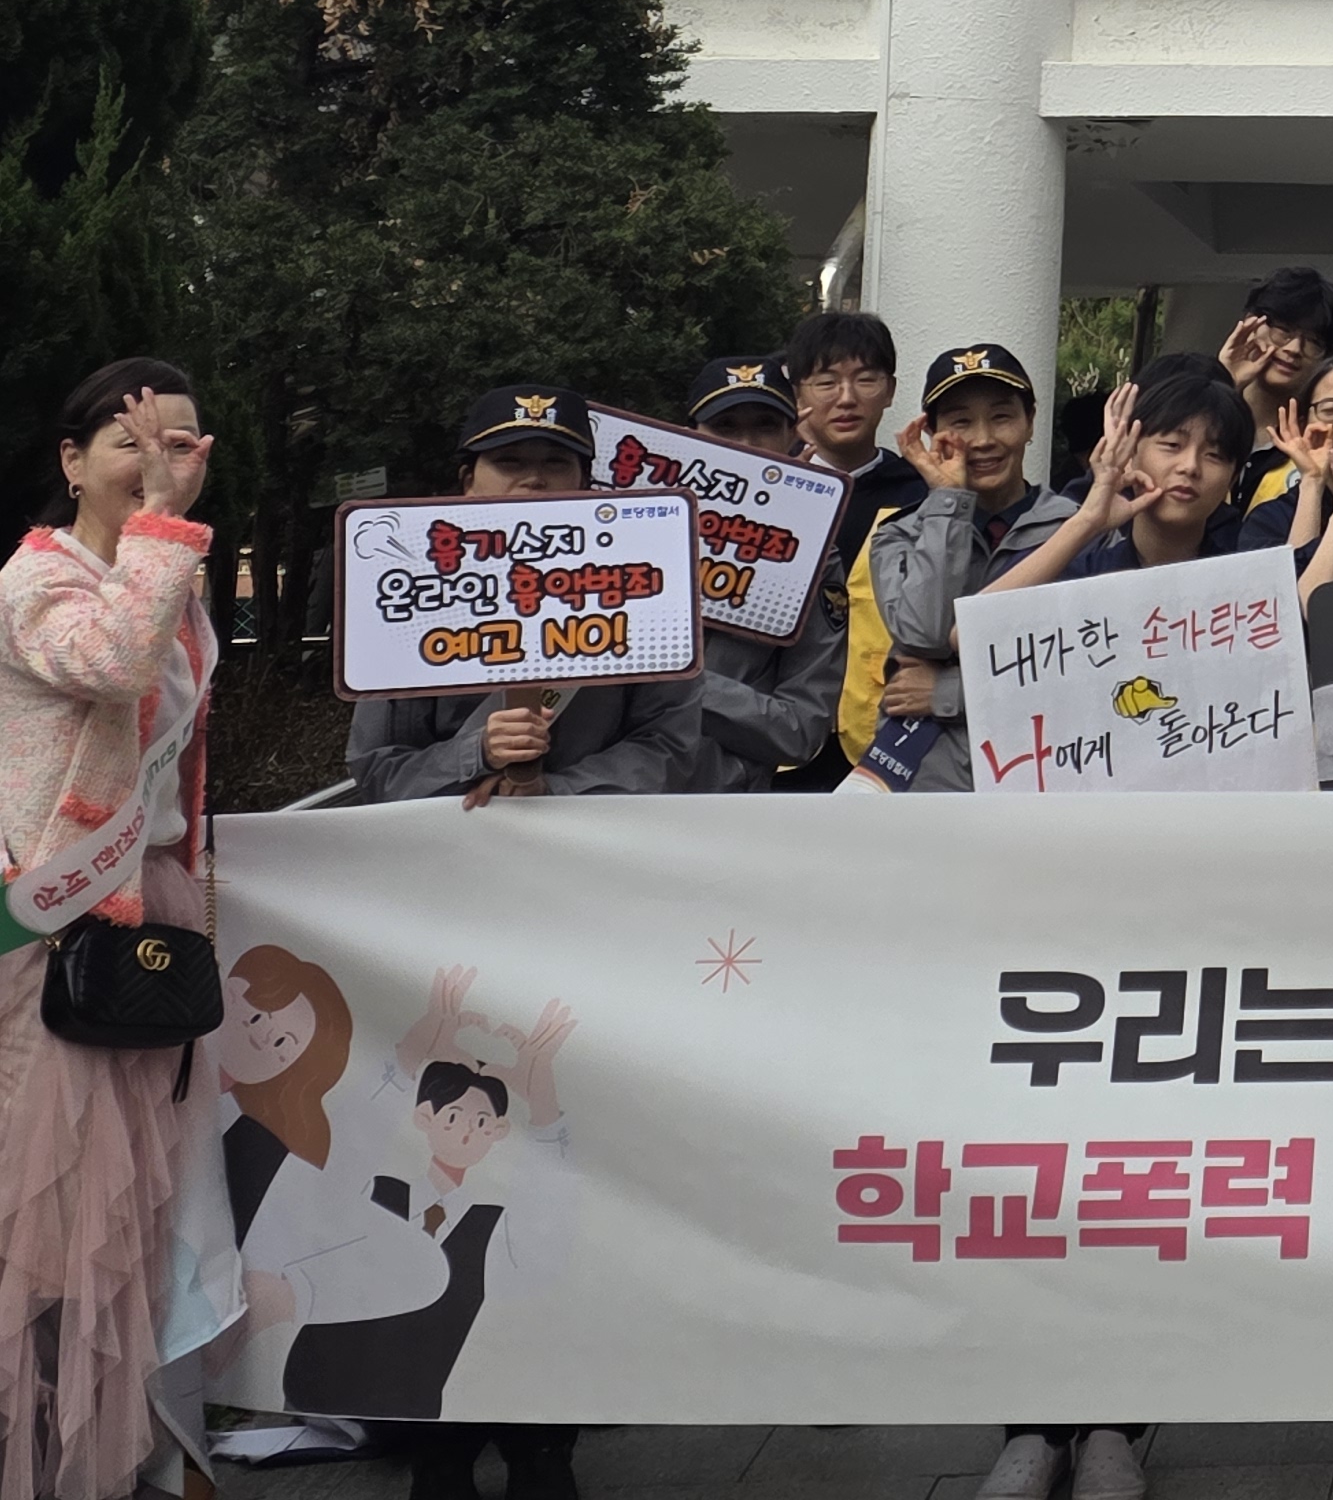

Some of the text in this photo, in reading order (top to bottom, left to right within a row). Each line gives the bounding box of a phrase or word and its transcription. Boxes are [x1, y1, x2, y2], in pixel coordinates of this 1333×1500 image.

[427, 520, 584, 574] 흉기소지
[699, 510, 799, 563] 악범죄
[376, 562, 663, 622] 온라인 흉악범죄
[420, 612, 628, 666] 예고 NO!
[1142, 597, 1282, 659] 손가락질
[980, 689, 1294, 793] 나에게 돌아온다
[33, 869, 92, 911] 세상
[832, 1134, 1316, 1263] 학교폭력
